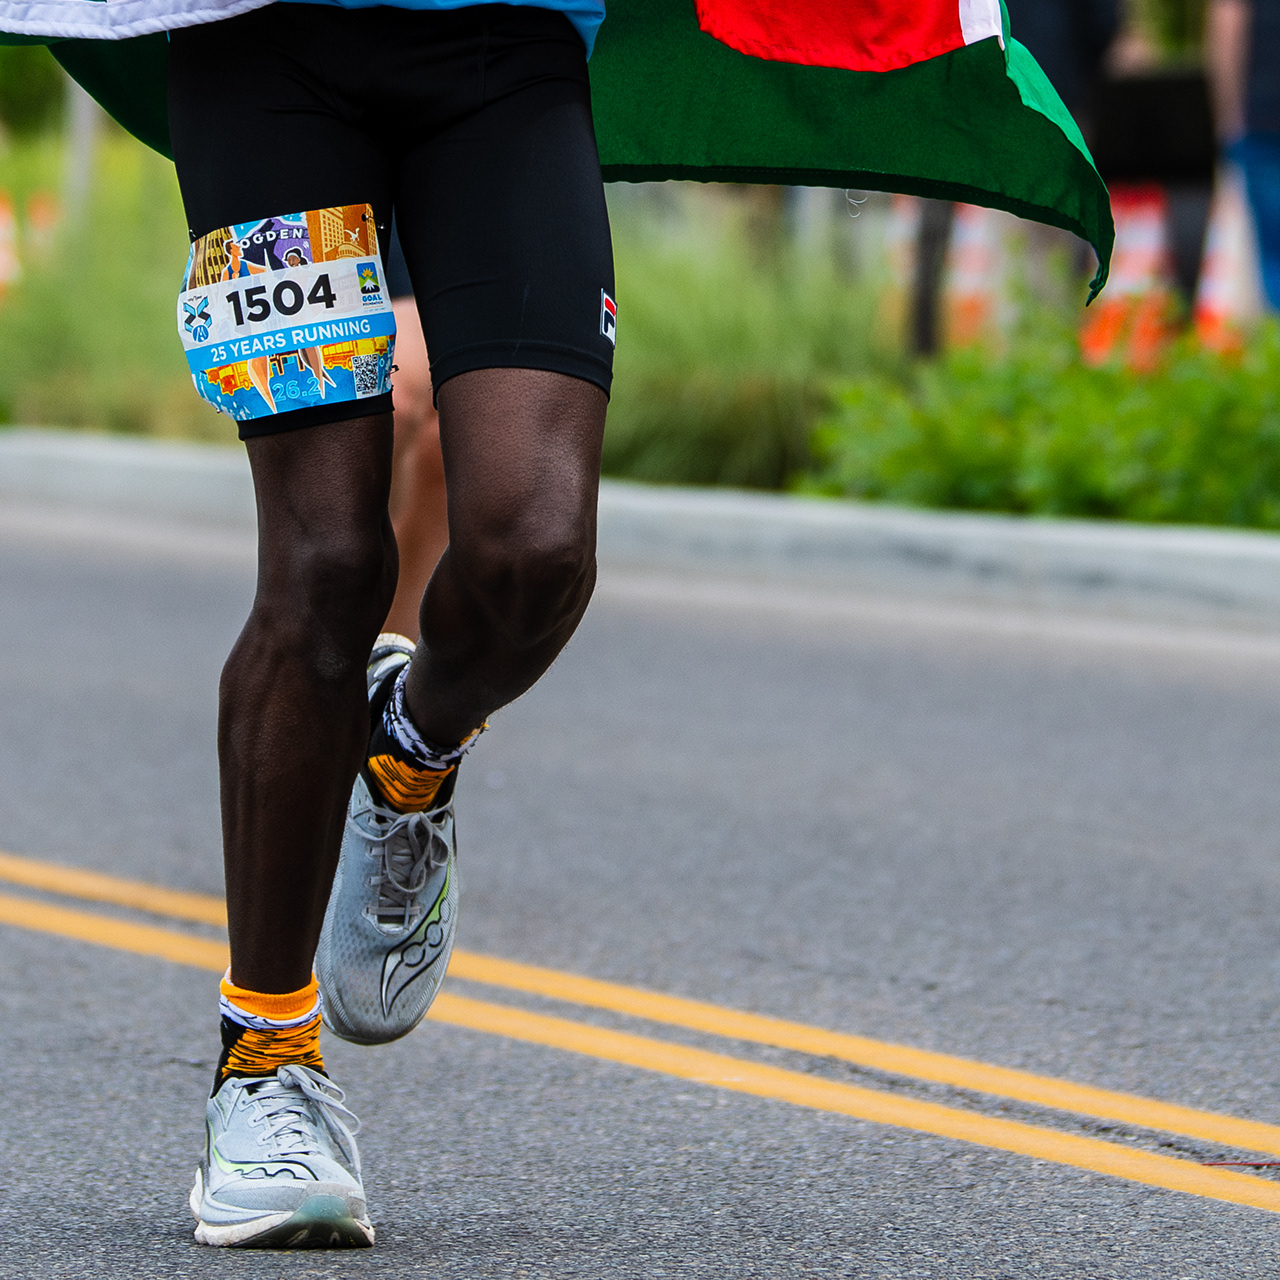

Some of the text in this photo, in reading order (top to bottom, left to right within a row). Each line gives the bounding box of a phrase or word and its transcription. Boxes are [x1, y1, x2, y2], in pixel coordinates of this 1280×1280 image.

[239, 228, 303, 249] OGDEN
[225, 273, 337, 326] 1504
[362, 294, 383, 302] GOAL
[210, 319, 371, 362] 25 YEARS RUNNING
[271, 376, 321, 402] 26.2
